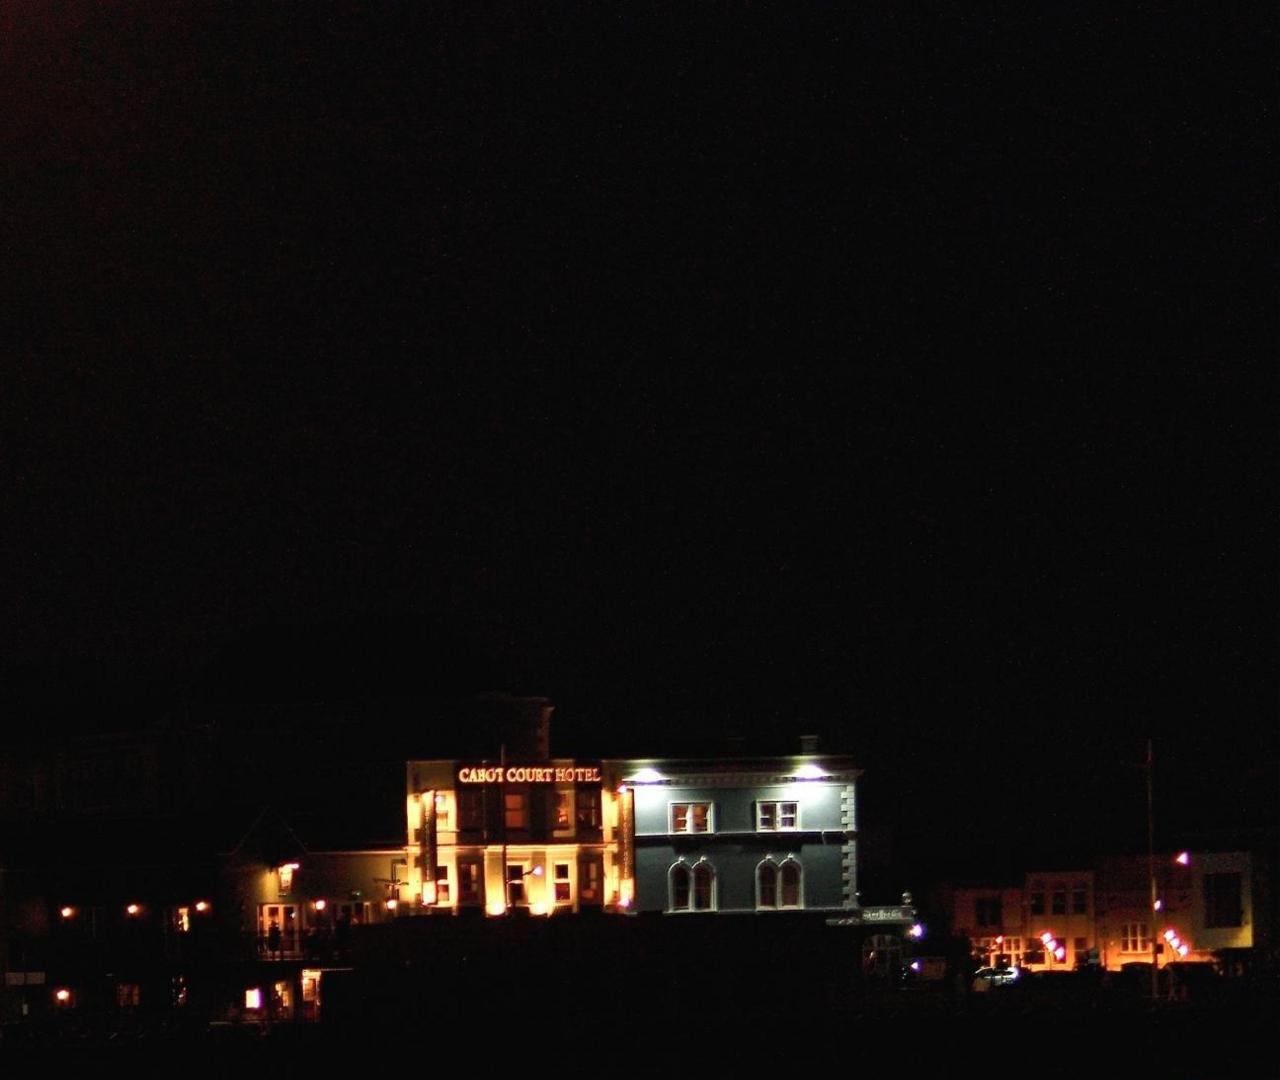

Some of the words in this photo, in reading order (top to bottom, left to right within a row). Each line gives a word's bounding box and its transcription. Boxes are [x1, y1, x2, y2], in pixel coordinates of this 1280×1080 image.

[459, 768, 504, 783] CABOT
[506, 768, 554, 783] COURT
[555, 768, 601, 783] HOTEL
